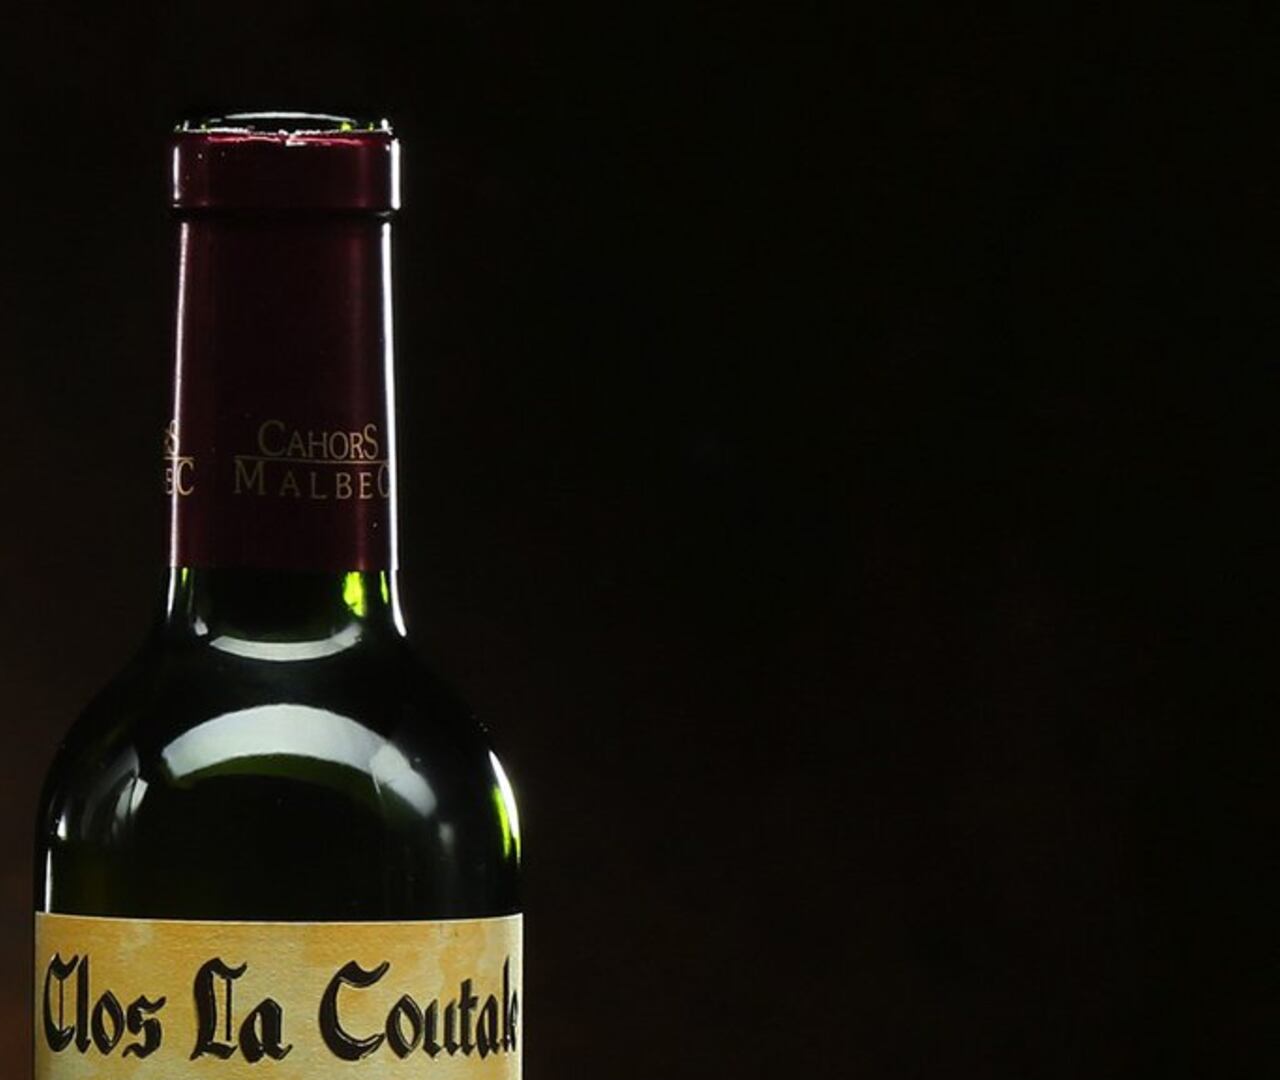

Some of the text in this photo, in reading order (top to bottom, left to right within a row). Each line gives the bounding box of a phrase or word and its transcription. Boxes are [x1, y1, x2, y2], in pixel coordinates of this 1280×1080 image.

[258, 420, 379, 460] CAHORS
[43, 952, 167, 1058] Clos
[190, 957, 293, 1063] La
